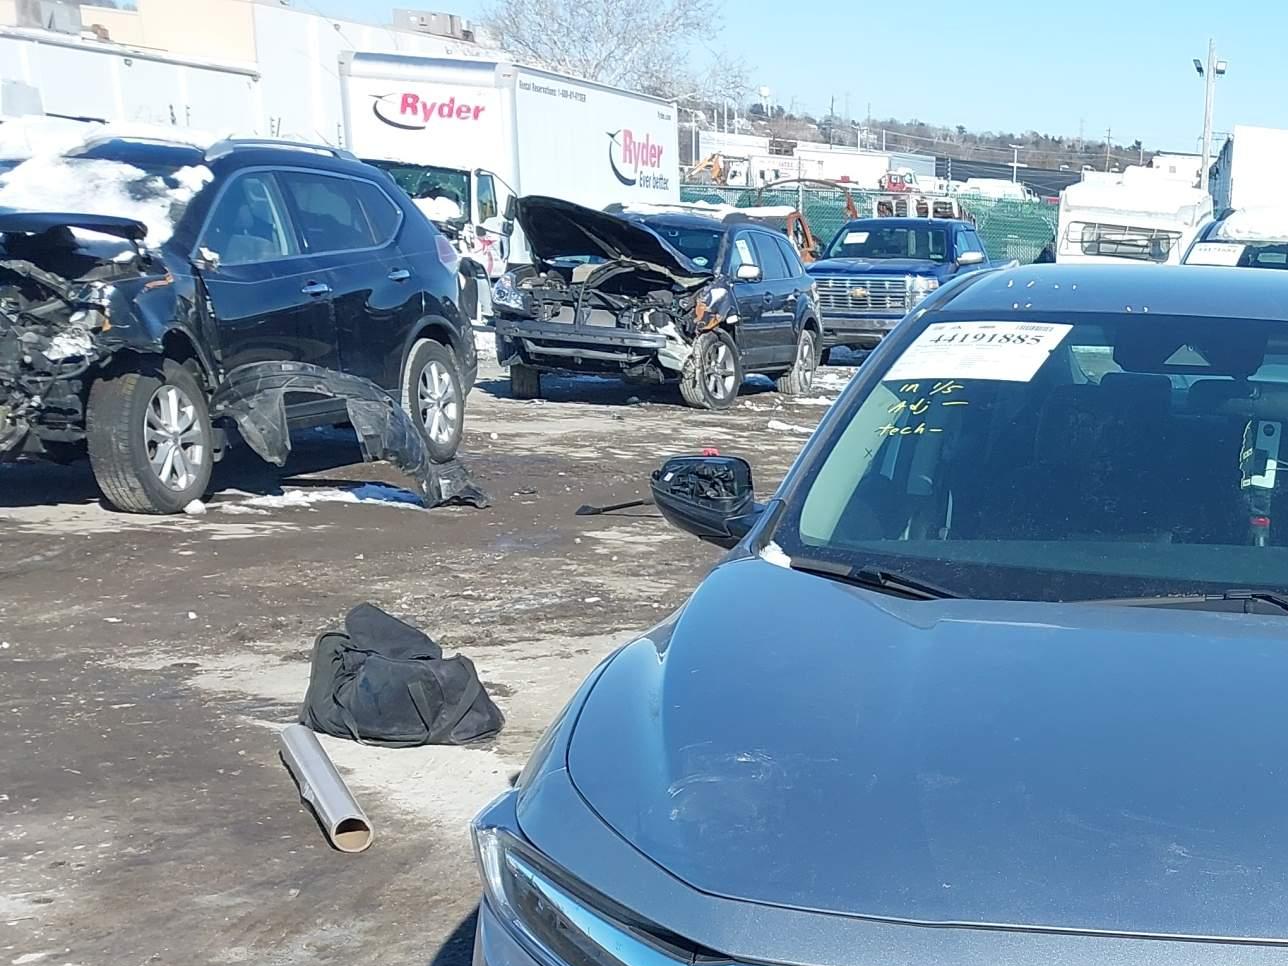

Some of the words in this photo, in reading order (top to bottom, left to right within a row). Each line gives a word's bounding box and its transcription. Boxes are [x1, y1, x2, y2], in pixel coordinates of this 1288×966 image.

[400, 92, 486, 123] Ryder
[622, 128, 664, 174] Ryder
[639, 170, 652, 188] Ever
[929, 333, 1045, 346] 44191885
